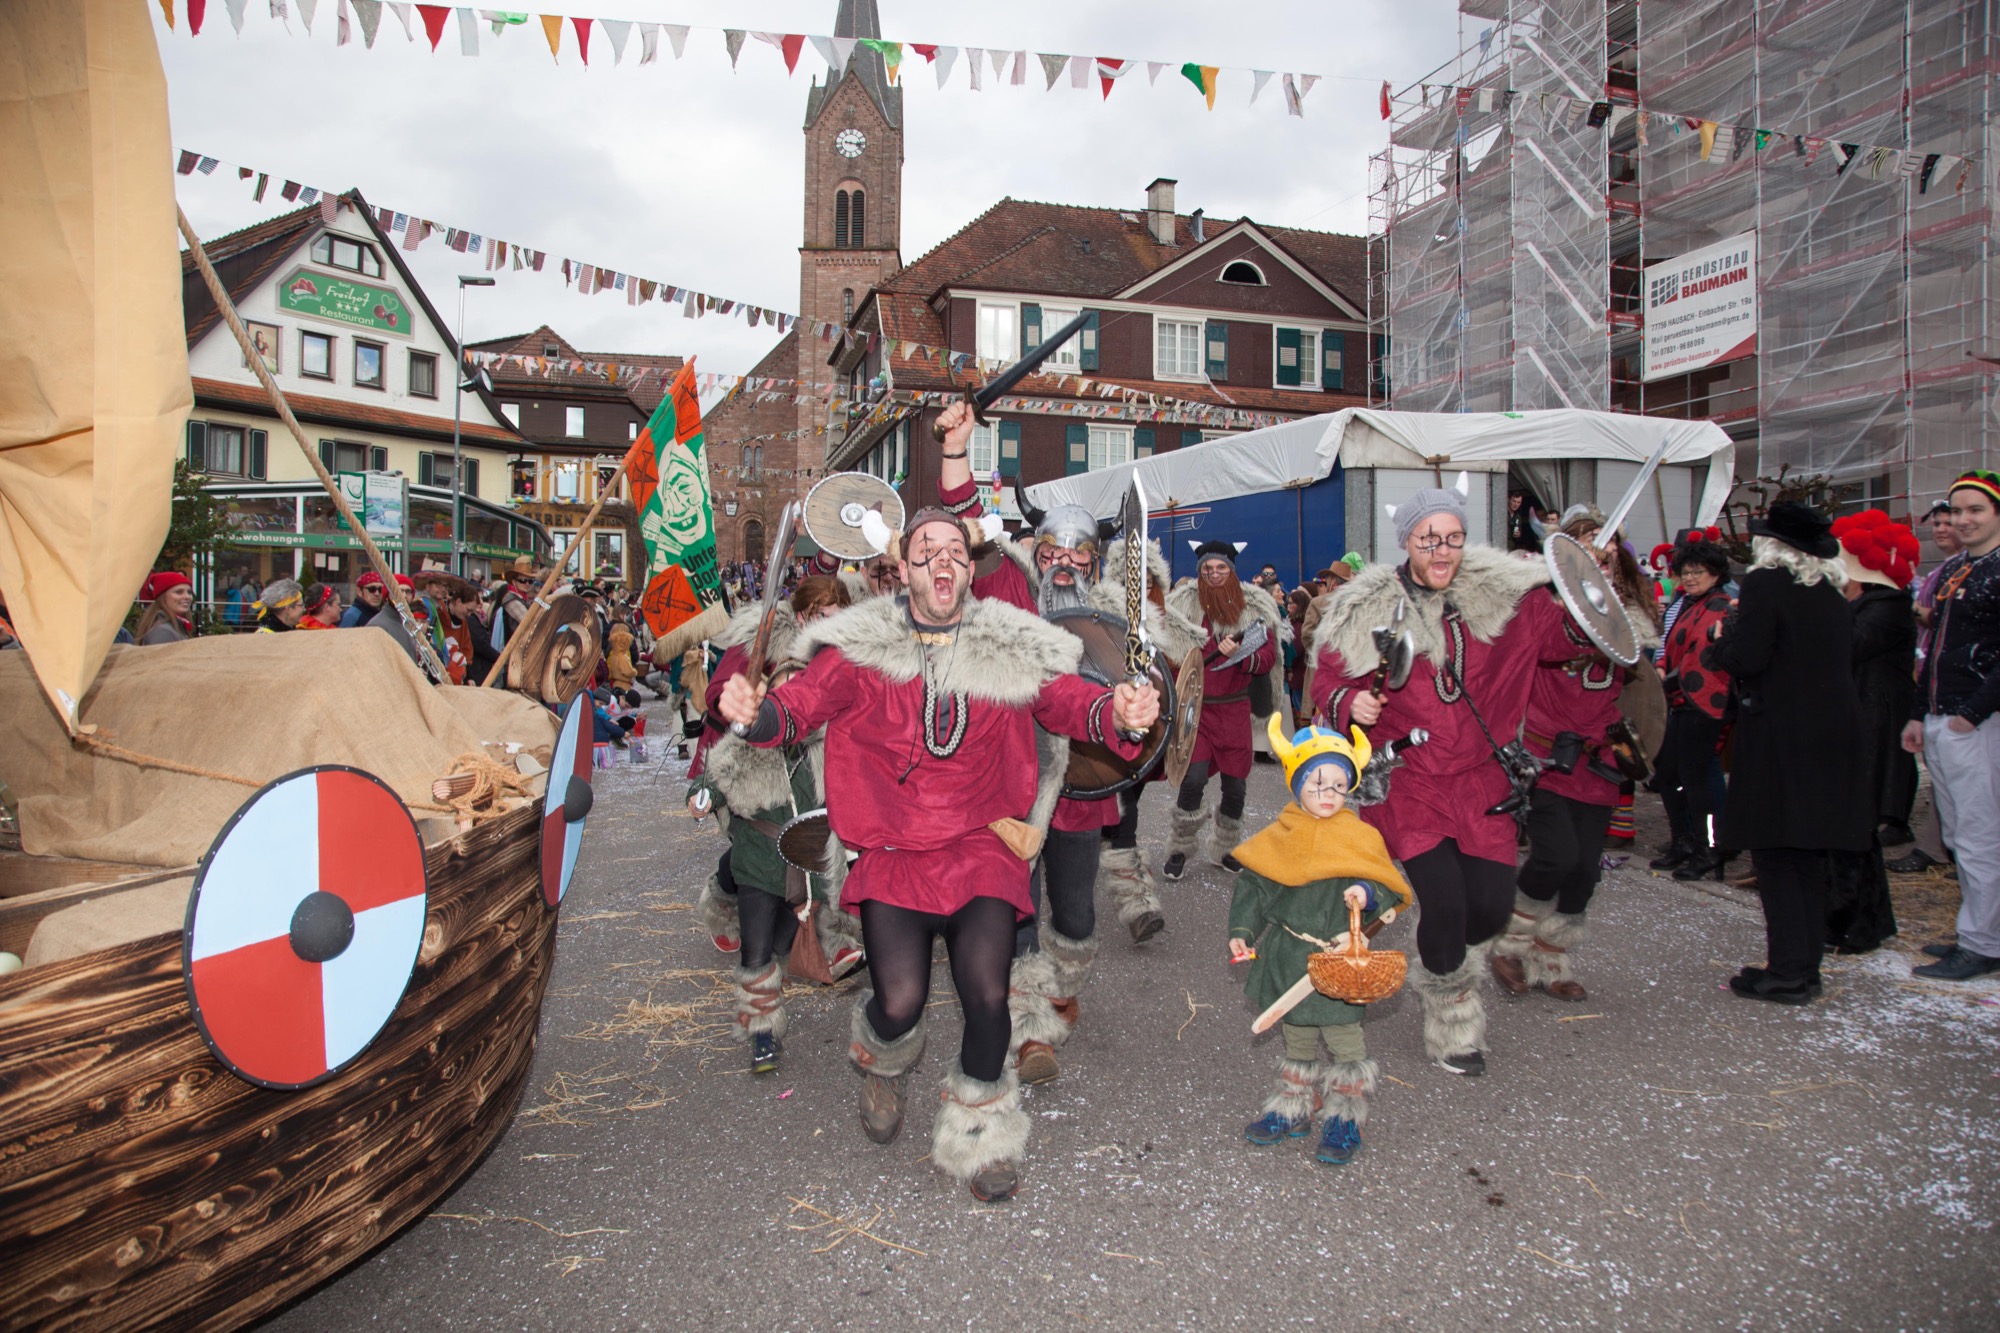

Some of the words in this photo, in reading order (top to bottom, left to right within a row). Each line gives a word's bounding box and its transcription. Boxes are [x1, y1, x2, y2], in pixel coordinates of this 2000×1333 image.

[1682, 250, 1748, 282] GERÜSTBAU
[1682, 267, 1748, 299] BAUMANN
[326, 285, 370, 307] Freihof
[320, 305, 375, 326] Restaurant
[1668, 312, 1695, 327] HAUSACH
[1698, 304, 1727, 318] Einbacher
[1651, 335, 1663, 345] Mail
